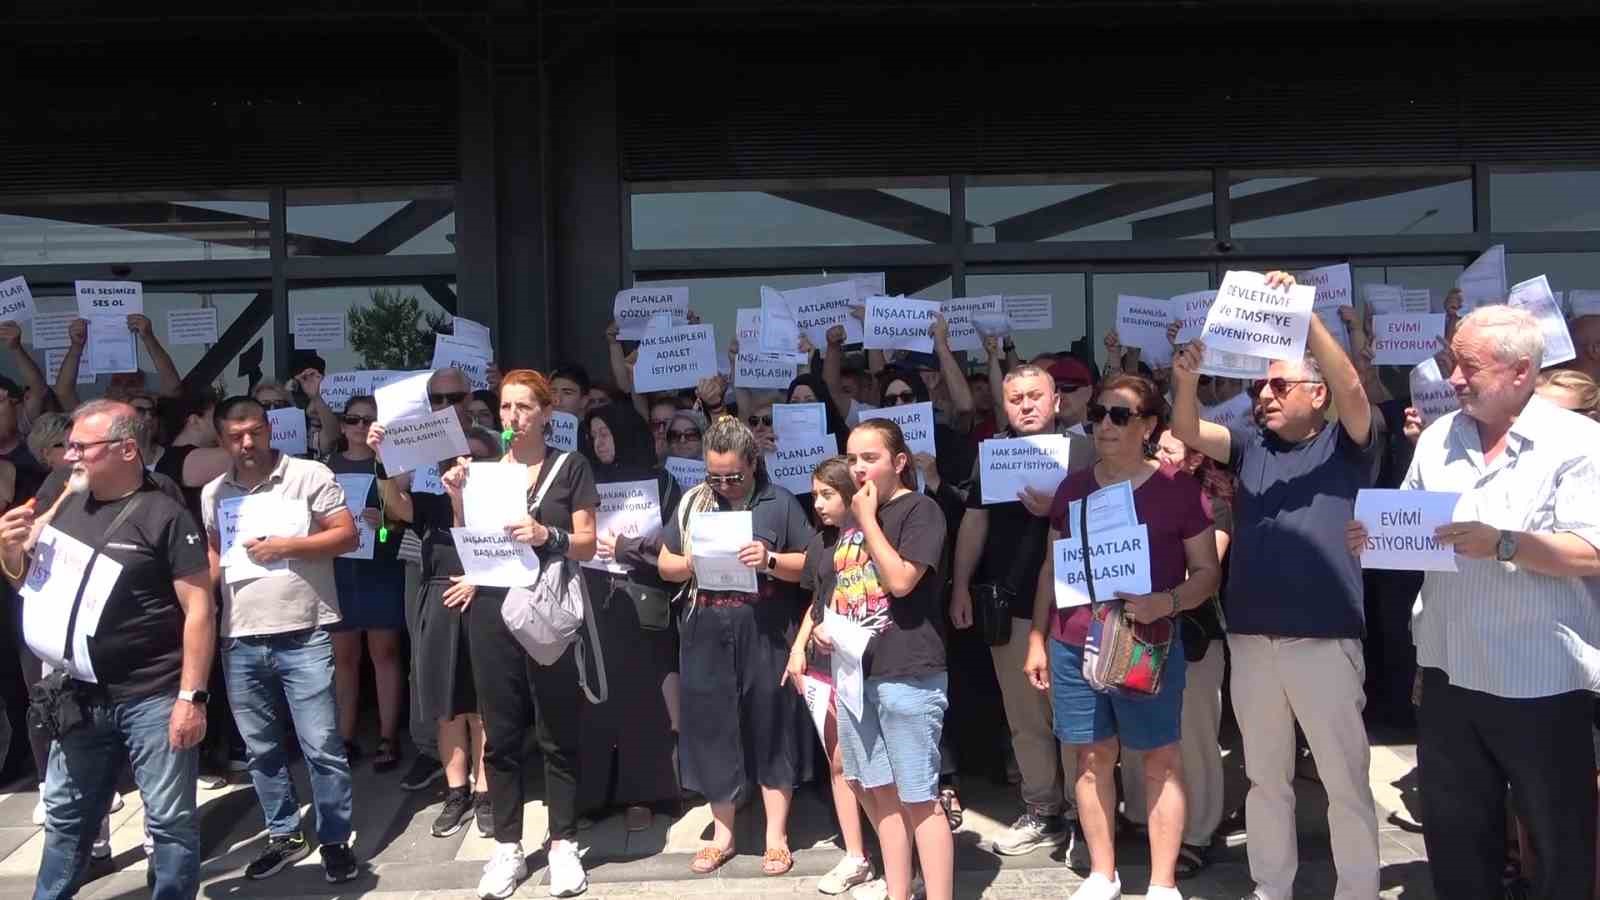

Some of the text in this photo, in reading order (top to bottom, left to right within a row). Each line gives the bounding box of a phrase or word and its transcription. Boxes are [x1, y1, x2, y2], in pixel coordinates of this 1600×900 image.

[80, 287, 96, 295] GEL
[92, 299, 125, 307] SES OL
[630, 294, 674, 304] PLANLAR
[1235, 306, 1293, 328] TMSF'YE
[1387, 319, 1422, 333] EVİMİ
[1207, 320, 1293, 348] GÜVENİYORUM
[656, 347, 691, 359] ADALET
[650, 361, 688, 376] İSTİYOR
[739, 367, 793, 382] BAŞLASIN
[775, 445, 825, 461] PLANLAR
[991, 446, 1011, 457] HAK
[990, 460, 1060, 471] ADALET İSTİYOR
[1380, 506, 1423, 527] EVİMİ
